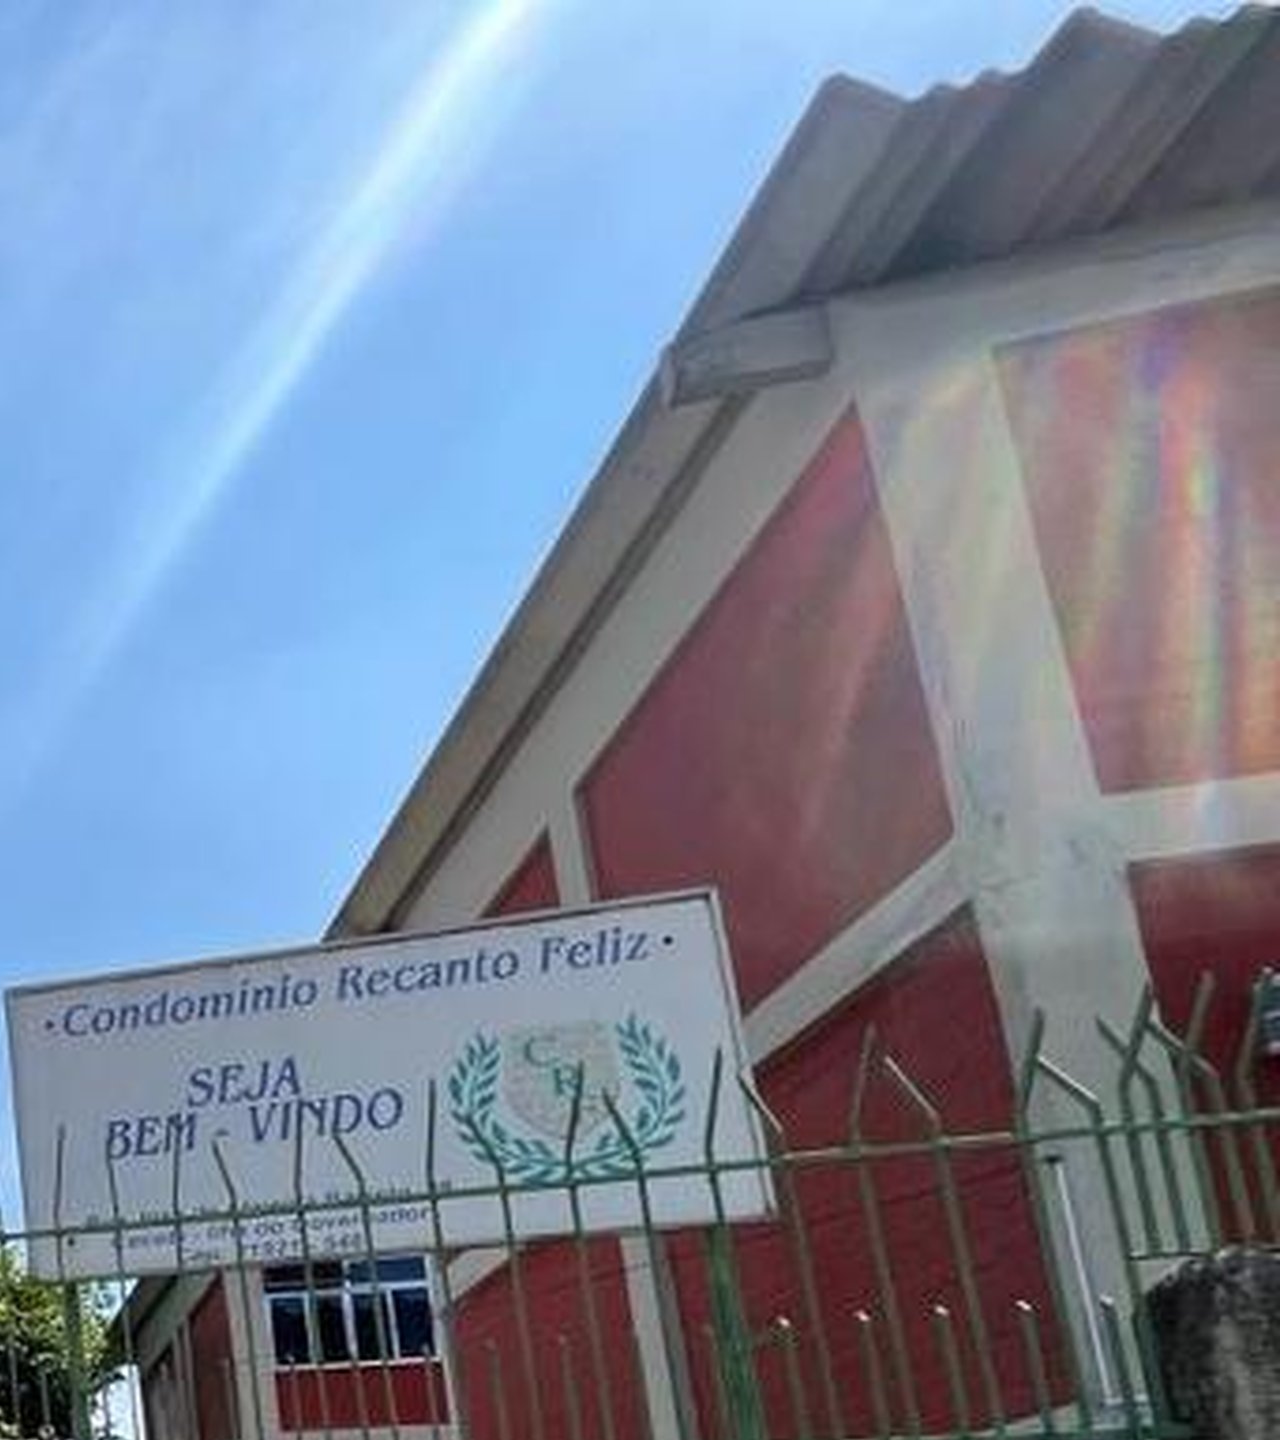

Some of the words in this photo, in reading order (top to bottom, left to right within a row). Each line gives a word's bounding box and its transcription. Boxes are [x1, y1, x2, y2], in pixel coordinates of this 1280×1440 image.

[63, 973, 318, 1037] Condominio
[336, 948, 520, 1001] Recanto
[540, 925, 649, 974] Feliz
[188, 1055, 301, 1107] SEJA
[105, 1112, 196, 1160] BEM
[247, 1087, 404, 1142] VINDO
